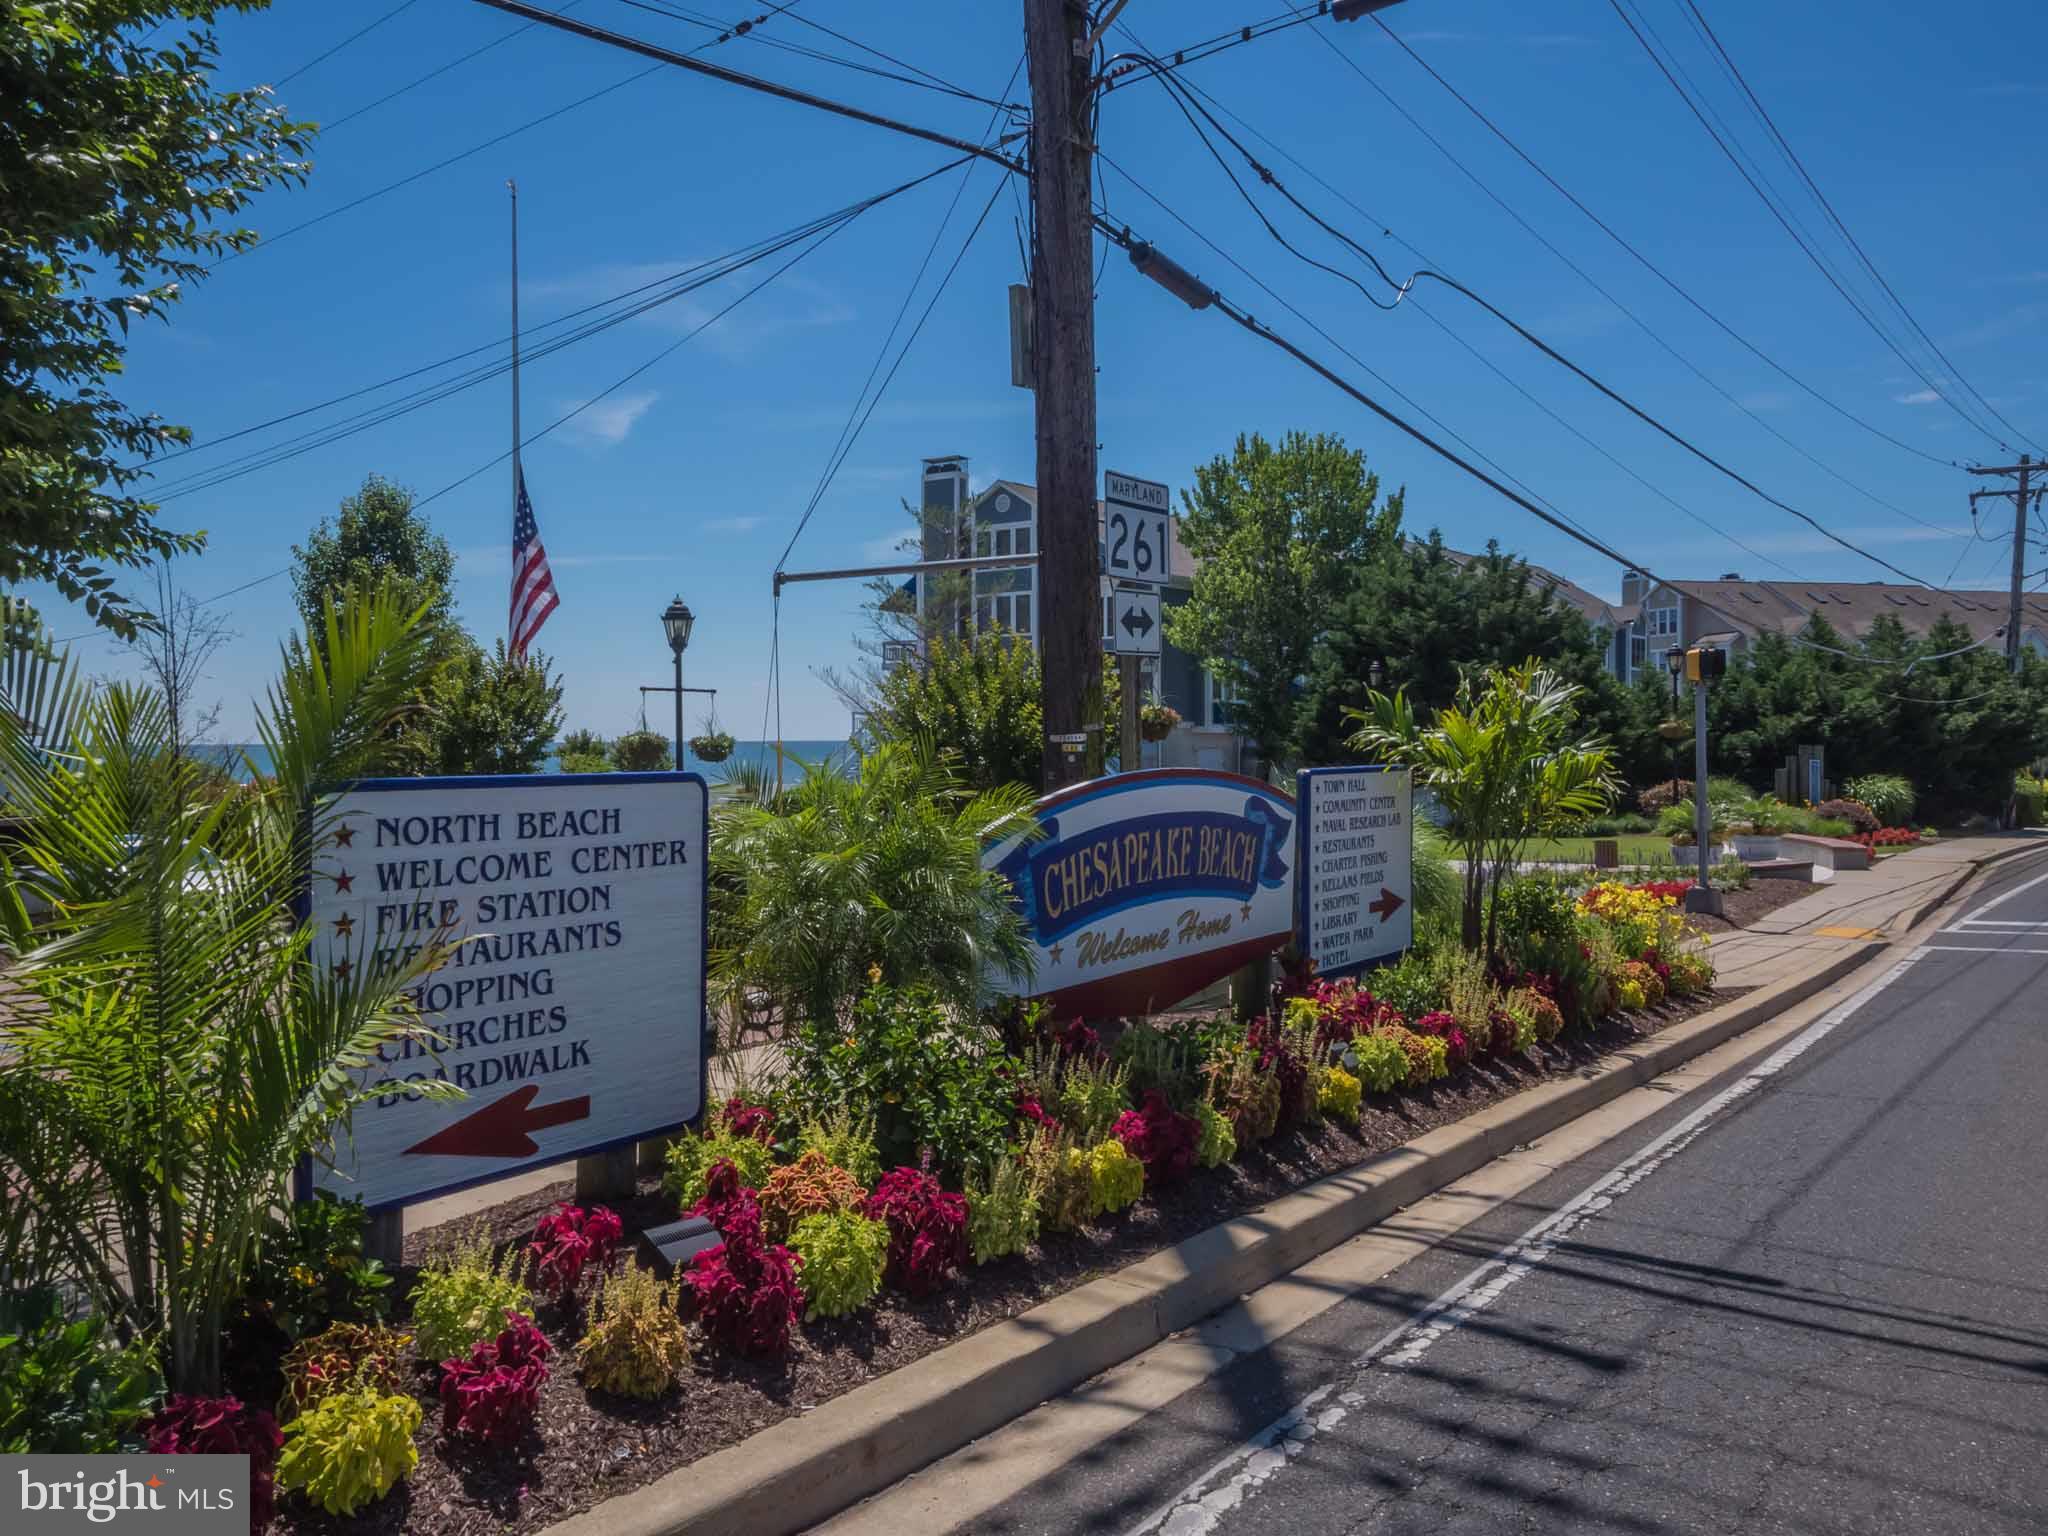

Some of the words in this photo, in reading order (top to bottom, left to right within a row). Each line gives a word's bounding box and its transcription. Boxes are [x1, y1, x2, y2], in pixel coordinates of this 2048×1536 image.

[1112, 478, 1162, 505] MARYLAND
[1111, 512, 1165, 575] 261
[1323, 780, 1345, 793] TOWN
[1348, 778, 1366, 793] HALL
[1322, 799, 1366, 814] COMMUNITY
[1369, 796, 1396, 810] CENTER
[376, 814, 500, 848] NORTH
[516, 809, 621, 840] BEACH
[1322, 818, 1346, 833] NAVAL
[1349, 814, 1386, 830] RESEARCH
[1388, 813, 1401, 827] LAB
[1322, 835, 1375, 854] RESTAURANTS
[376, 851, 552, 892] WELCOME
[572, 840, 688, 874] CENTER
[1044, 826, 1193, 919] CHESAPEAKE
[1197, 825, 1257, 883] BEACH
[1322, 856, 1359, 873] CHARTER
[1361, 851, 1388, 869] FISHING
[1322, 874, 1358, 893] KELLAMS
[1360, 870, 1384, 888] FIELDS
[376, 899, 462, 936] FIRE
[477, 885, 611, 923] STATION
[1322, 893, 1360, 912] SHOPPING
[1322, 912, 1358, 931] LIBRARY
[376, 921, 621, 978] RETAURANTS
[1076, 927, 1170, 968] Welcome
[1177, 909, 1232, 944] Home
[1322, 932, 1350, 950] WATER
[1353, 926, 1375, 944] PARK
[1322, 951, 1350, 969] HOTEL
[384, 969, 554, 1014] HOPPING
